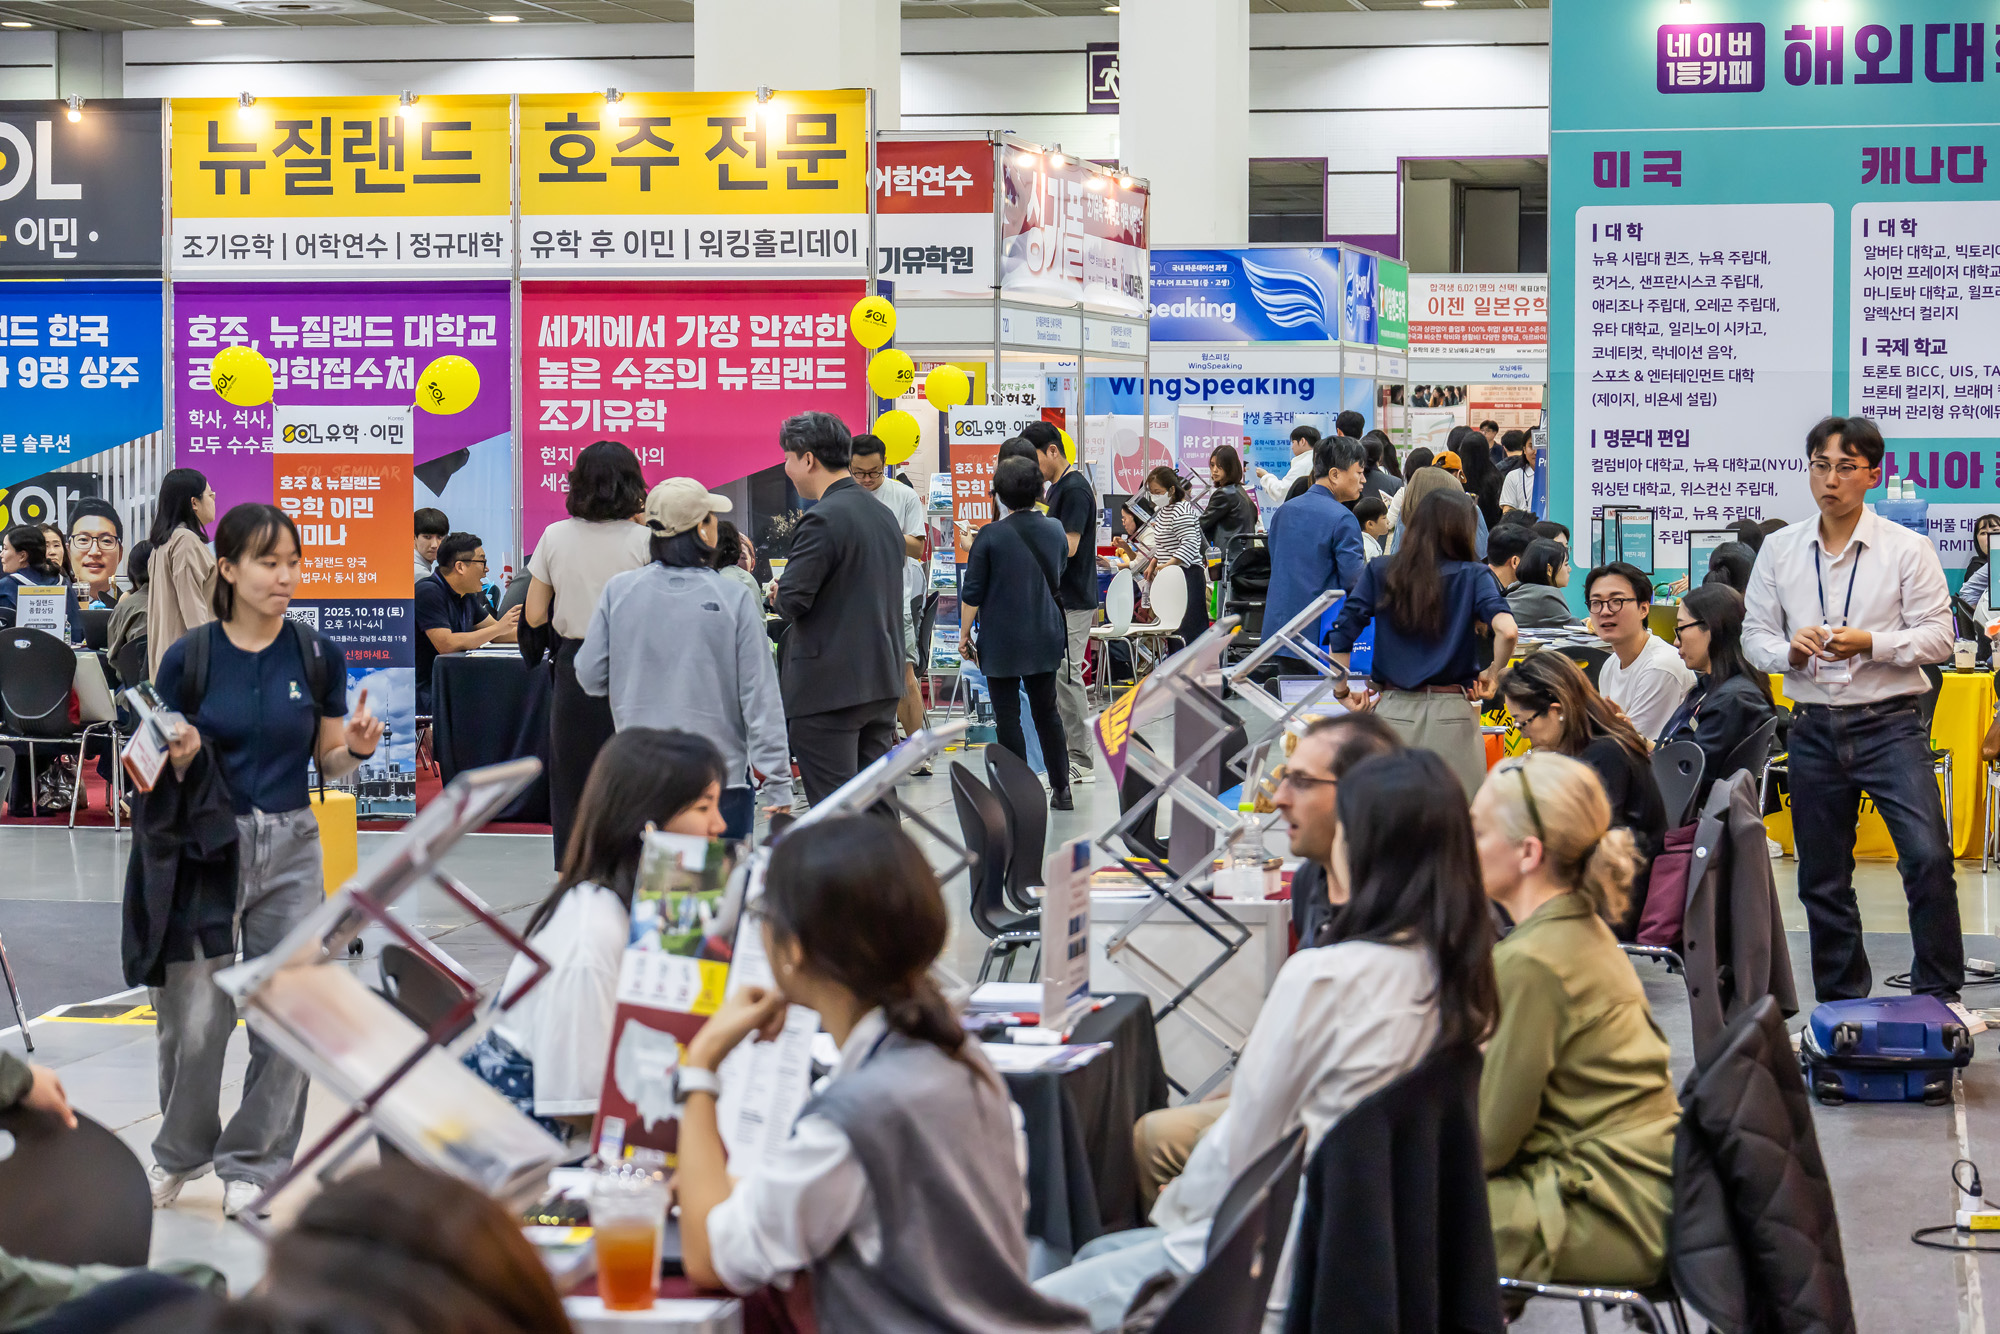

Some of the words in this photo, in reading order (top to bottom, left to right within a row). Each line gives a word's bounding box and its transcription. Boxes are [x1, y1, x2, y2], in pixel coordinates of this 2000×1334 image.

[1784, 22, 2000, 86] 해외대
[1666, 61, 1752, 86] 1등카페
[200, 116, 481, 195] 뉴질랜드
[539, 112, 679, 192] 호주
[705, 113, 846, 190] 전문
[1861, 145, 1987, 184] 캐나다
[1605, 223, 1643, 241] 대학
[1879, 218, 1917, 237] 대학
[15, 217, 78, 258] 이민
[182, 232, 274, 260] 조기유학
[295, 232, 388, 260] 어학연수
[409, 231, 503, 259] 정규대학
[530, 230, 582, 259] 유학
[589, 230, 616, 259] 후
[624, 230, 674, 259] 이민
[699, 228, 857, 259] 워킹홀리데이
[866, 246, 973, 274] 기유학원
[1592, 252, 1618, 266] 뉴욕
[1622, 252, 1660, 266] 시립대
[1664, 251, 1694, 267] 퀸즈,
[1698, 251, 1724, 265] 뉴욕
[1728, 250, 1771, 265] 주립대,
[1864, 245, 1904, 260] 알버타
[1907, 245, 1951, 260] 대학교,
[1864, 265, 1903, 280] 사이먼
[1907, 265, 1959, 280] 프레이저
[1430, 283, 1455, 292] 합격생
[1499, 283, 1518, 292] 선택!
[1592, 276, 1635, 290] 럿거스,
[1639, 275, 1717, 290] 샌프란시스코
[1720, 274, 1764, 289] 주립대,
[1864, 286, 1916, 300] 마니토바
[1919, 286, 1963, 300] 대학교,
[1428, 297, 1464, 317] 이젠
[1592, 299, 1644, 313] 애리조나
[1647, 298, 1690, 313] 주립대,
[1694, 298, 1733, 312] 오레곤
[1737, 297, 1780, 312] 주립대,
[1864, 306, 1915, 321] 알렉산더
[1919, 306, 1959, 320] 컬리지
[865, 309, 887, 324] SOL
[48, 314, 109, 347] 한국
[188, 314, 259, 351] 호주,
[269, 315, 393, 348] 뉴질랜드
[404, 314, 497, 348] 대학교
[538, 314, 666, 348] 세계에서
[676, 314, 741, 348] 가장
[750, 312, 847, 349] 안전한
[1592, 322, 1618, 337] 유타
[1621, 322, 1664, 337] 대학교,
[1669, 322, 1720, 336] 일리노이
[1724, 321, 1767, 336] 시카고,
[1592, 346, 1647, 360] 코네티컷,
[1652, 345, 1703, 360] 락네이션
[1707, 345, 1737, 360] 음악,
[1875, 337, 1909, 357] 국제
[1914, 337, 1948, 357] 학교
[18, 356, 69, 389] 9명
[79, 356, 139, 389] 상주
[539, 357, 601, 390] 높은
[611, 357, 706, 390] 수준의
[717, 357, 847, 390] 뉴질랜드
[1188, 362, 1243, 370] WingSpeaking
[1862, 365, 1902, 379] 토론토
[1906, 365, 1944, 379] BICC,
[1950, 365, 1978, 379] UIS,
[1592, 369, 1630, 383] 스포츠
[1634, 370, 1644, 382] &
[1647, 368, 1725, 383] 엔터테인먼트
[1728, 368, 1755, 383] 대학
[1592, 392, 1640, 407] (제이지,
[1644, 392, 1683, 407] 비욘세
[1686, 391, 1717, 407] 설립)
[1862, 385, 1902, 399] 브론테
[1905, 385, 1949, 399] 컬리지,
[1953, 384, 1992, 399] 브래머
[188, 410, 227, 430] 학사,
[232, 410, 271, 430] 석사,
[539, 399, 667, 432] 조기유학
[1862, 405, 1901, 420] 밴쿠버
[1905, 405, 1944, 420] 관리형
[283, 424, 323, 444] SOL
[326, 423, 359, 444] 유학
[370, 423, 404, 444] 이민
[955, 420, 982, 436] SOL
[984, 420, 1006, 437] 유학
[22, 434, 71, 453] 솔루션
[188, 437, 222, 453] 모두
[1604, 428, 1652, 448] 명문대
[1657, 428, 1690, 447] 편입
[540, 446, 574, 466] 현지
[955, 463, 974, 474] 호주
[976, 463, 989, 474] &
[1591, 458, 1643, 472] 컬럼비아
[1646, 458, 1689, 473] 대학교,
[1693, 458, 1719, 472] 뉴욕
[1722, 457, 1808, 473] 대학교(NYU),
[280, 476, 307, 490] 호주
[311, 476, 322, 490] &
[326, 476, 381, 490] 뉴질랜드
[956, 479, 985, 497] 유학
[1591, 482, 1630, 496] 워싱턴
[1632, 482, 1676, 497] 대학교,
[1680, 482, 1731, 496] 위스컨신
[1735, 482, 1779, 497] 주립대,
[280, 497, 324, 519] 유학
[331, 497, 374, 519] 이민
[1693, 506, 1719, 520] 뉴욕
[1722, 506, 1765, 521] 주립대,
[1940, 540, 1974, 551] RMIT
[304, 557, 344, 568] 뉴질랜드
[346, 557, 367, 568] 양국
[334, 572, 354, 583] 동시
[357, 572, 377, 583] 참여
[324, 607, 384, 617] 2025.10.18
[324, 619, 344, 630] 오후
[347, 619, 383, 630] 1시-4시
